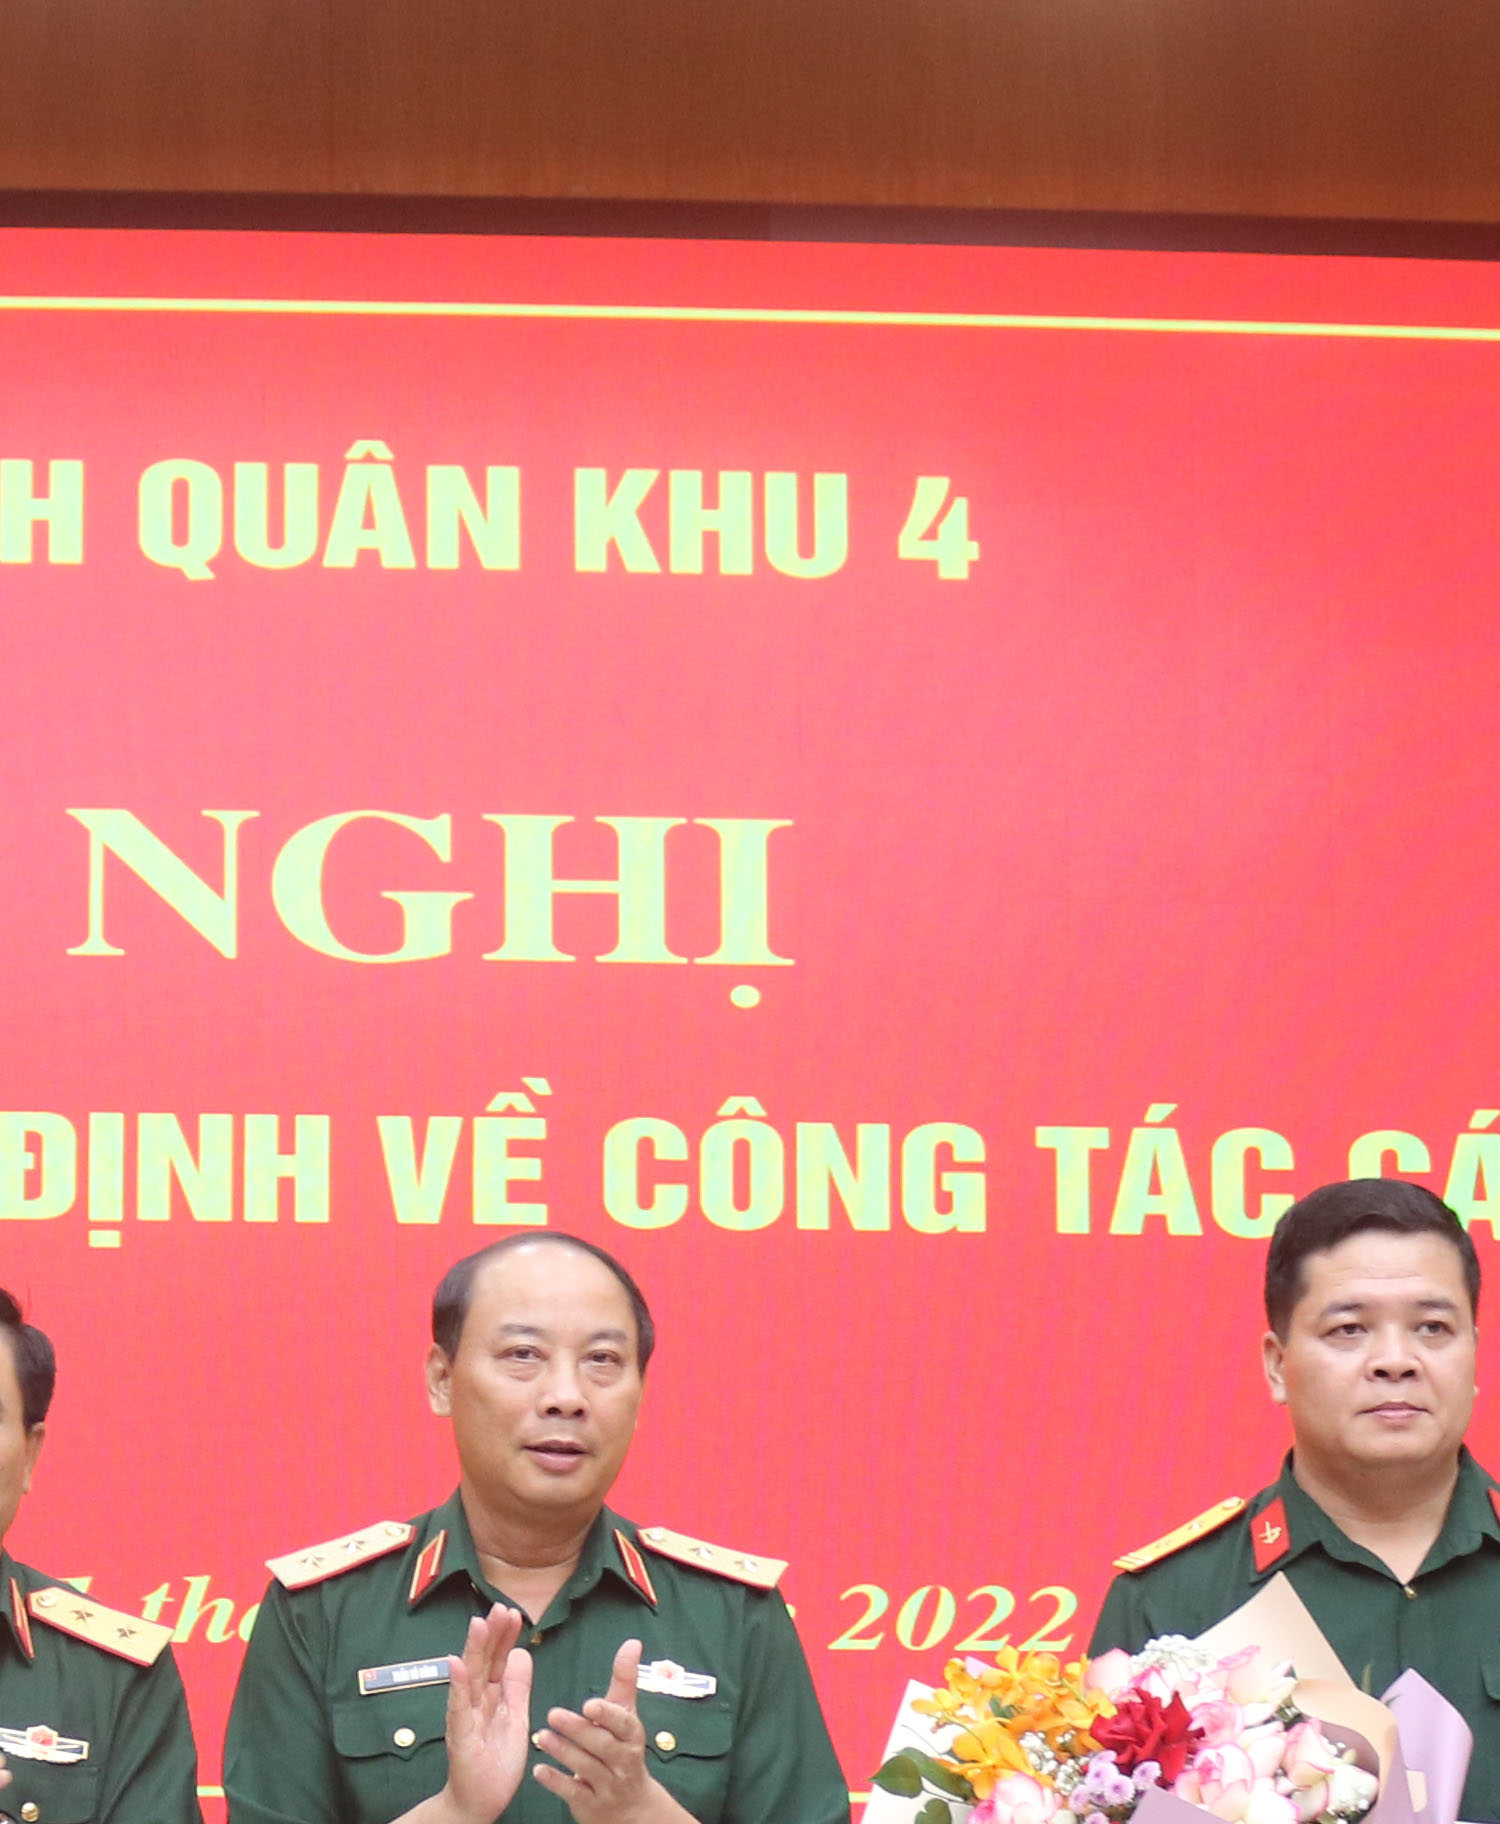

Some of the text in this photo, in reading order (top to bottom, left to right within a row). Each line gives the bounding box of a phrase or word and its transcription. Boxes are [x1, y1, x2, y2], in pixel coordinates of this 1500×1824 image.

[138, 439, 522, 582] QUÂN
[573, 467, 850, 581] KHU
[897, 476, 981, 581] 4
[65, 806, 796, 1010] NGHỊ
[376, 1073, 548, 1226] VỀ
[603, 1095, 987, 1234] CÔNG
[1035, 1103, 1296, 1240] TÁC
[827, 1583, 1079, 1652] 2022
